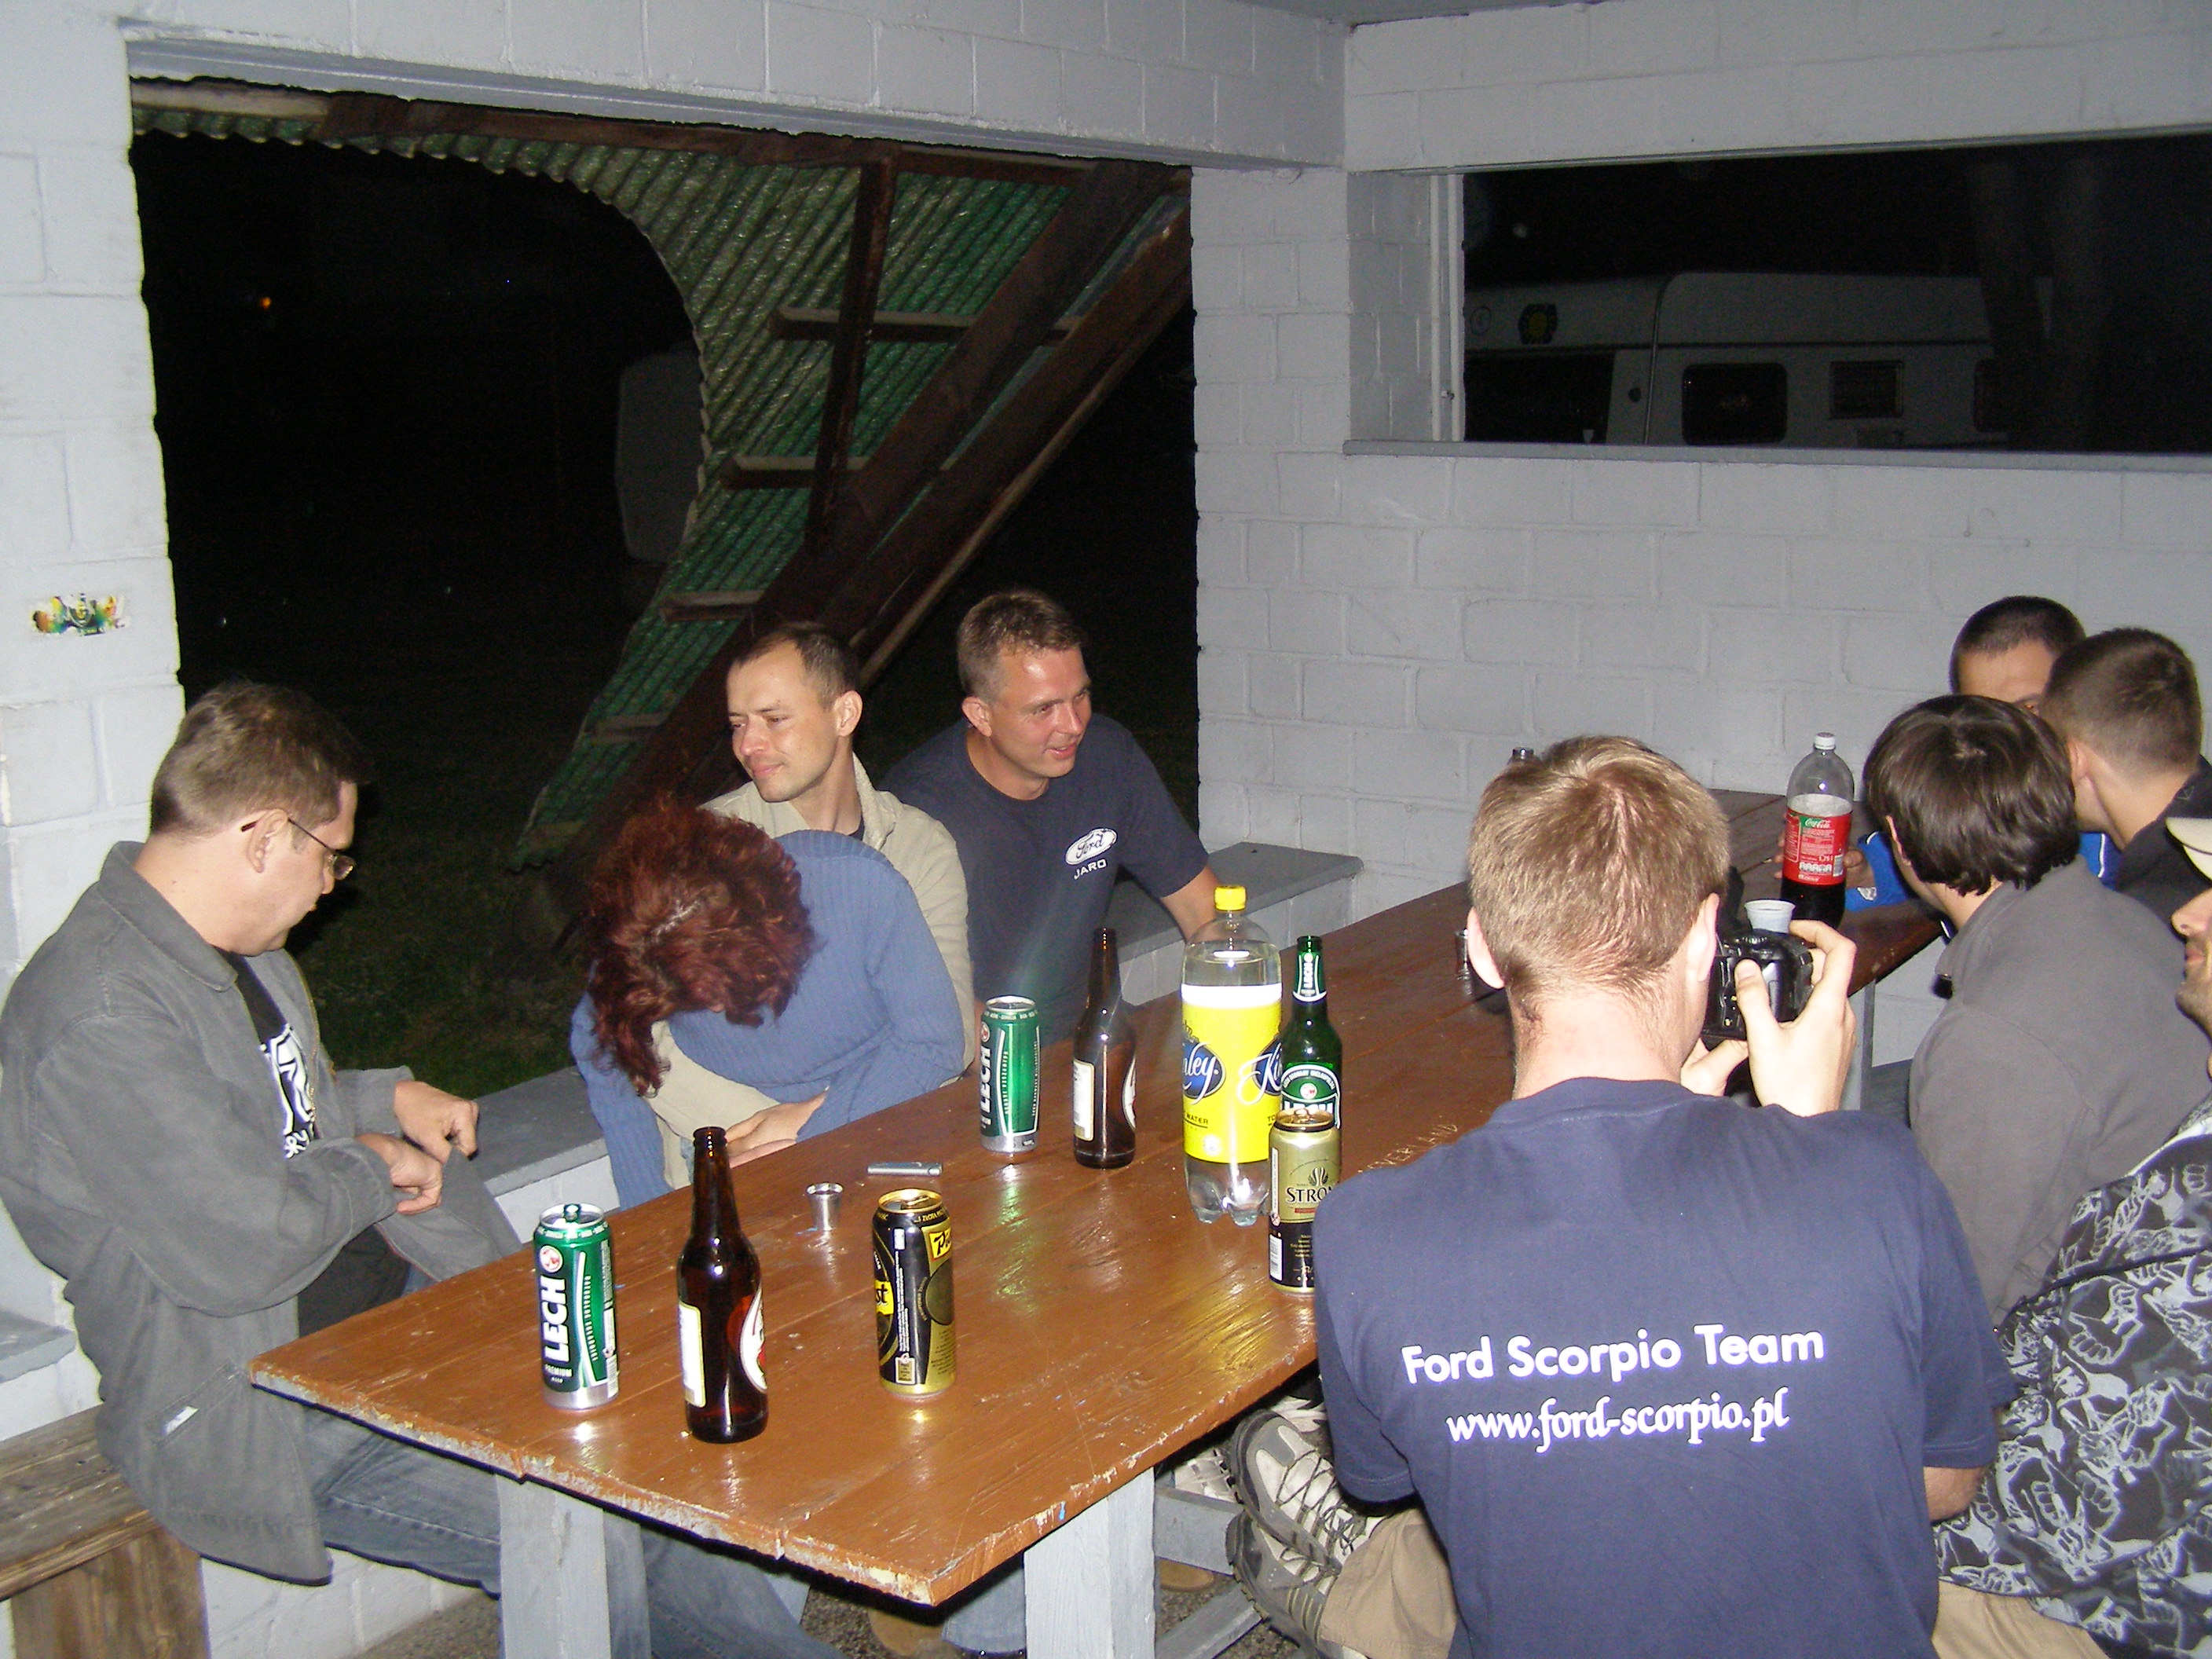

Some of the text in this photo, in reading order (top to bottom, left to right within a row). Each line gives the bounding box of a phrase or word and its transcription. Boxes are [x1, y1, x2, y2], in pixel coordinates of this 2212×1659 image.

[1073, 859, 1107, 880] JARO
[1075, 833, 1104, 859] Ford
[980, 1046, 991, 1114] LECH
[1286, 1185, 1332, 1203] STRO
[540, 1275, 570, 1362] LECH
[1401, 1324, 1825, 1384] Ford Scorpio Team
[1445, 1386, 1790, 1453] www.ford-scorpio.pl
